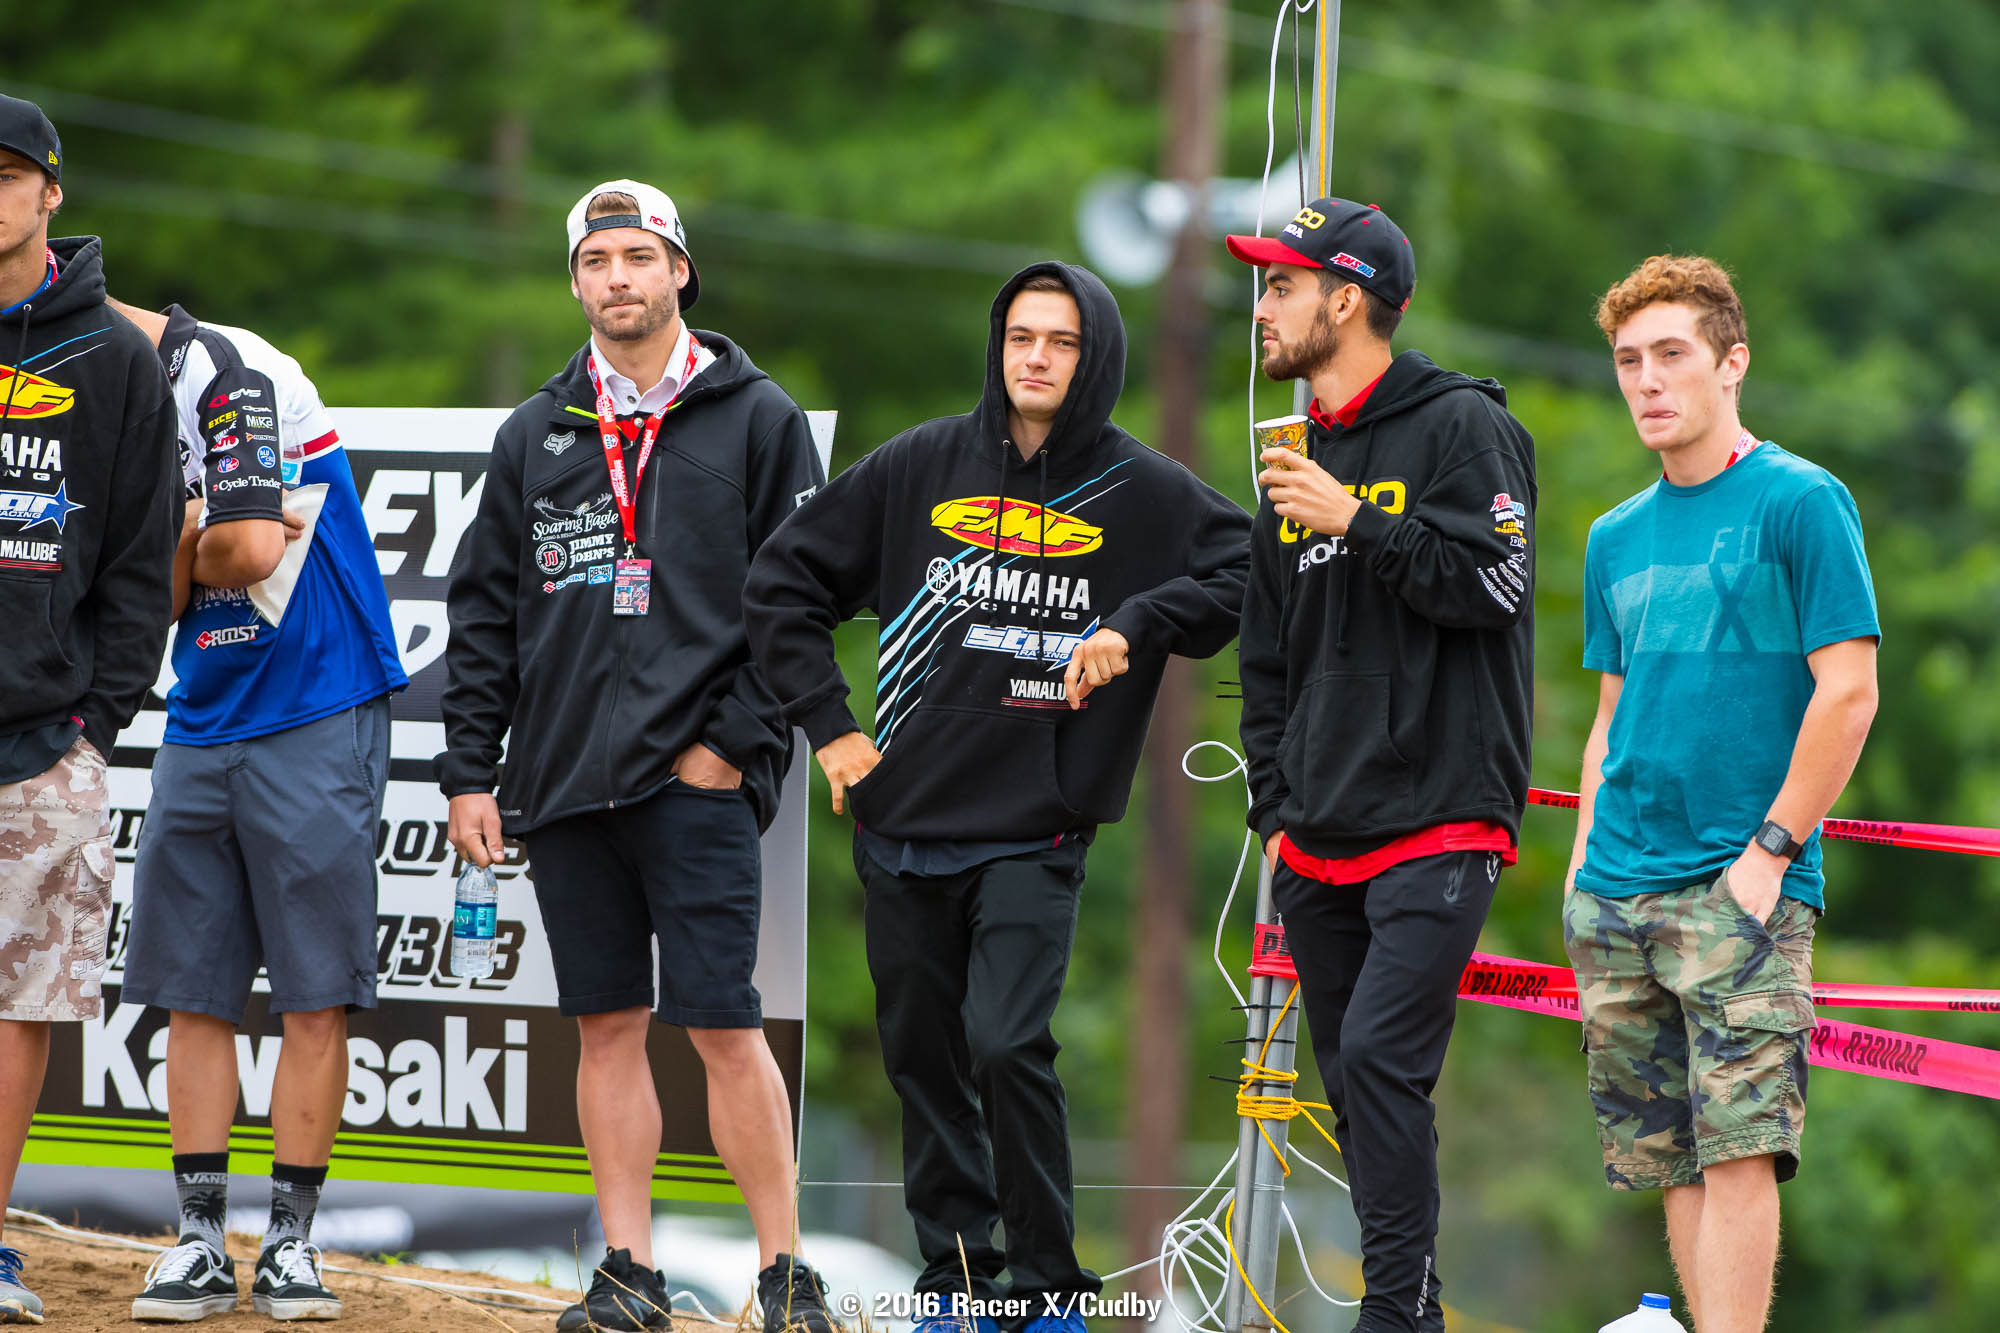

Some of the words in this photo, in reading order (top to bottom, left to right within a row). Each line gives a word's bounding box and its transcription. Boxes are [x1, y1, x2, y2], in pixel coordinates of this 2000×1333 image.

[1330, 252, 1377, 279] AMSOIL
[208, 410, 239, 430] EXCEL
[218, 477, 249, 492] Cycle
[248, 475, 282, 489] Trader
[0, 510, 42, 519] ACING
[532, 517, 583, 541] Soaring
[584, 509, 619, 533] Eagle
[930, 502, 1104, 547] FMF
[0, 539, 57, 562] MALUBE
[568, 533, 615, 555] JIMMY
[569, 547, 615, 569] JOHN'S
[957, 561, 1091, 611] YAMAHA
[934, 597, 1079, 621] RACING
[1020, 649, 1070, 660] RAING
[1009, 678, 1067, 701] YAMALU
[182, 1172, 227, 1185] VANS
